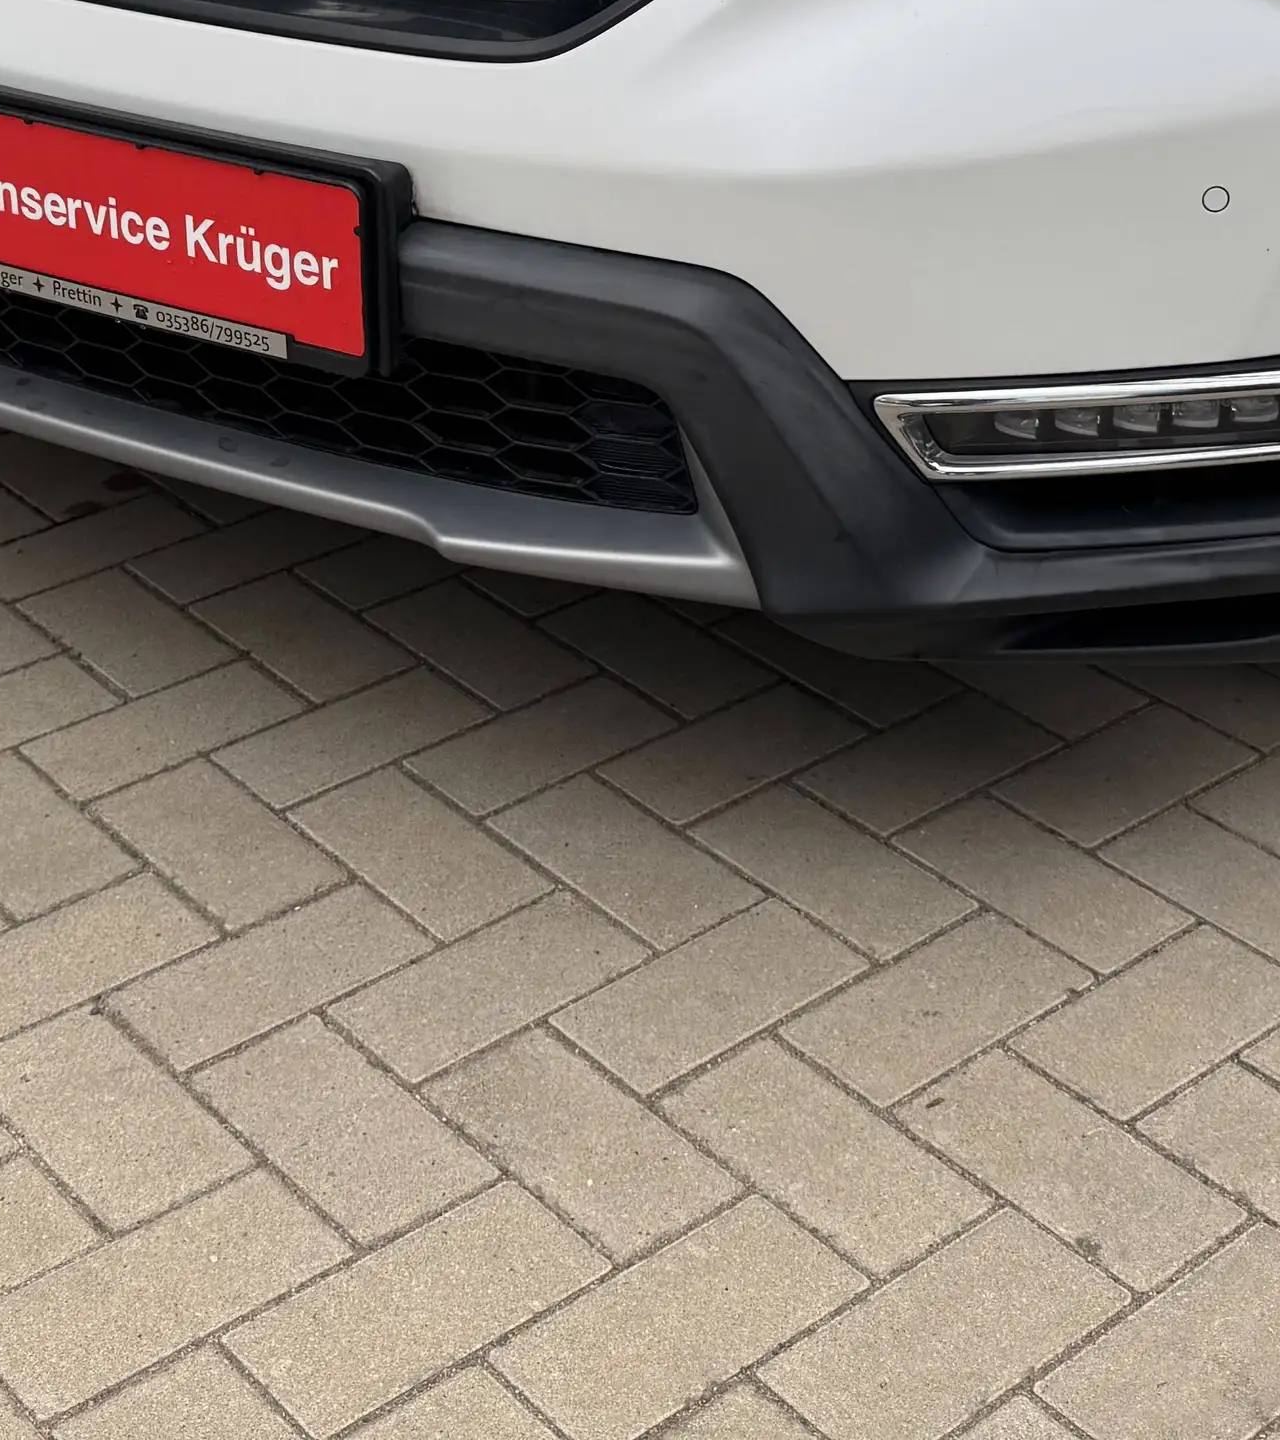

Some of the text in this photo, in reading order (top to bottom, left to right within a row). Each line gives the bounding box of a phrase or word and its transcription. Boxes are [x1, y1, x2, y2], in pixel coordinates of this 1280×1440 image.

[185, 214, 339, 291] Krüger
[53, 280, 102, 308] Prettin
[156, 310, 270, 352] 035386/799525
